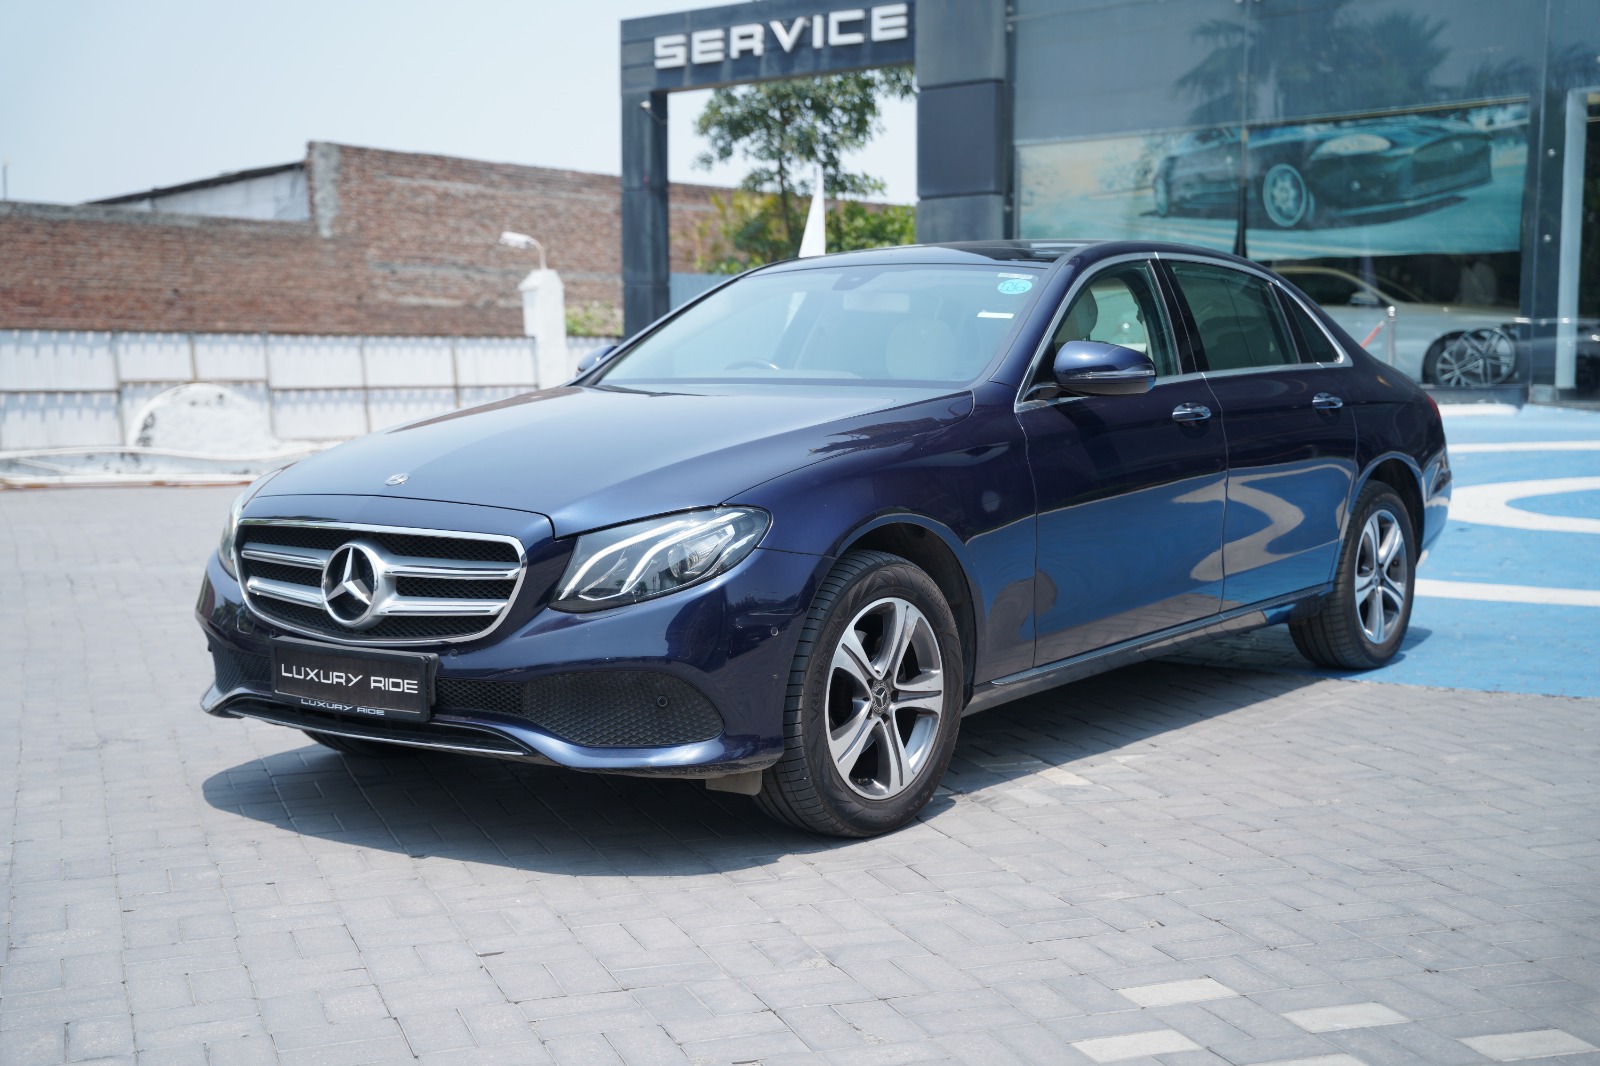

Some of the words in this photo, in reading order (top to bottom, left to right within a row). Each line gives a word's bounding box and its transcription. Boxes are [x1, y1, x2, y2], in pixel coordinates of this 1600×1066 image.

[654, 3, 908, 69] SERVICE
[281, 663, 363, 687] LUXURY
[370, 676, 418, 694] RIDE
[301, 698, 353, 711] LUXURY
[357, 707, 385, 716] RIDE
